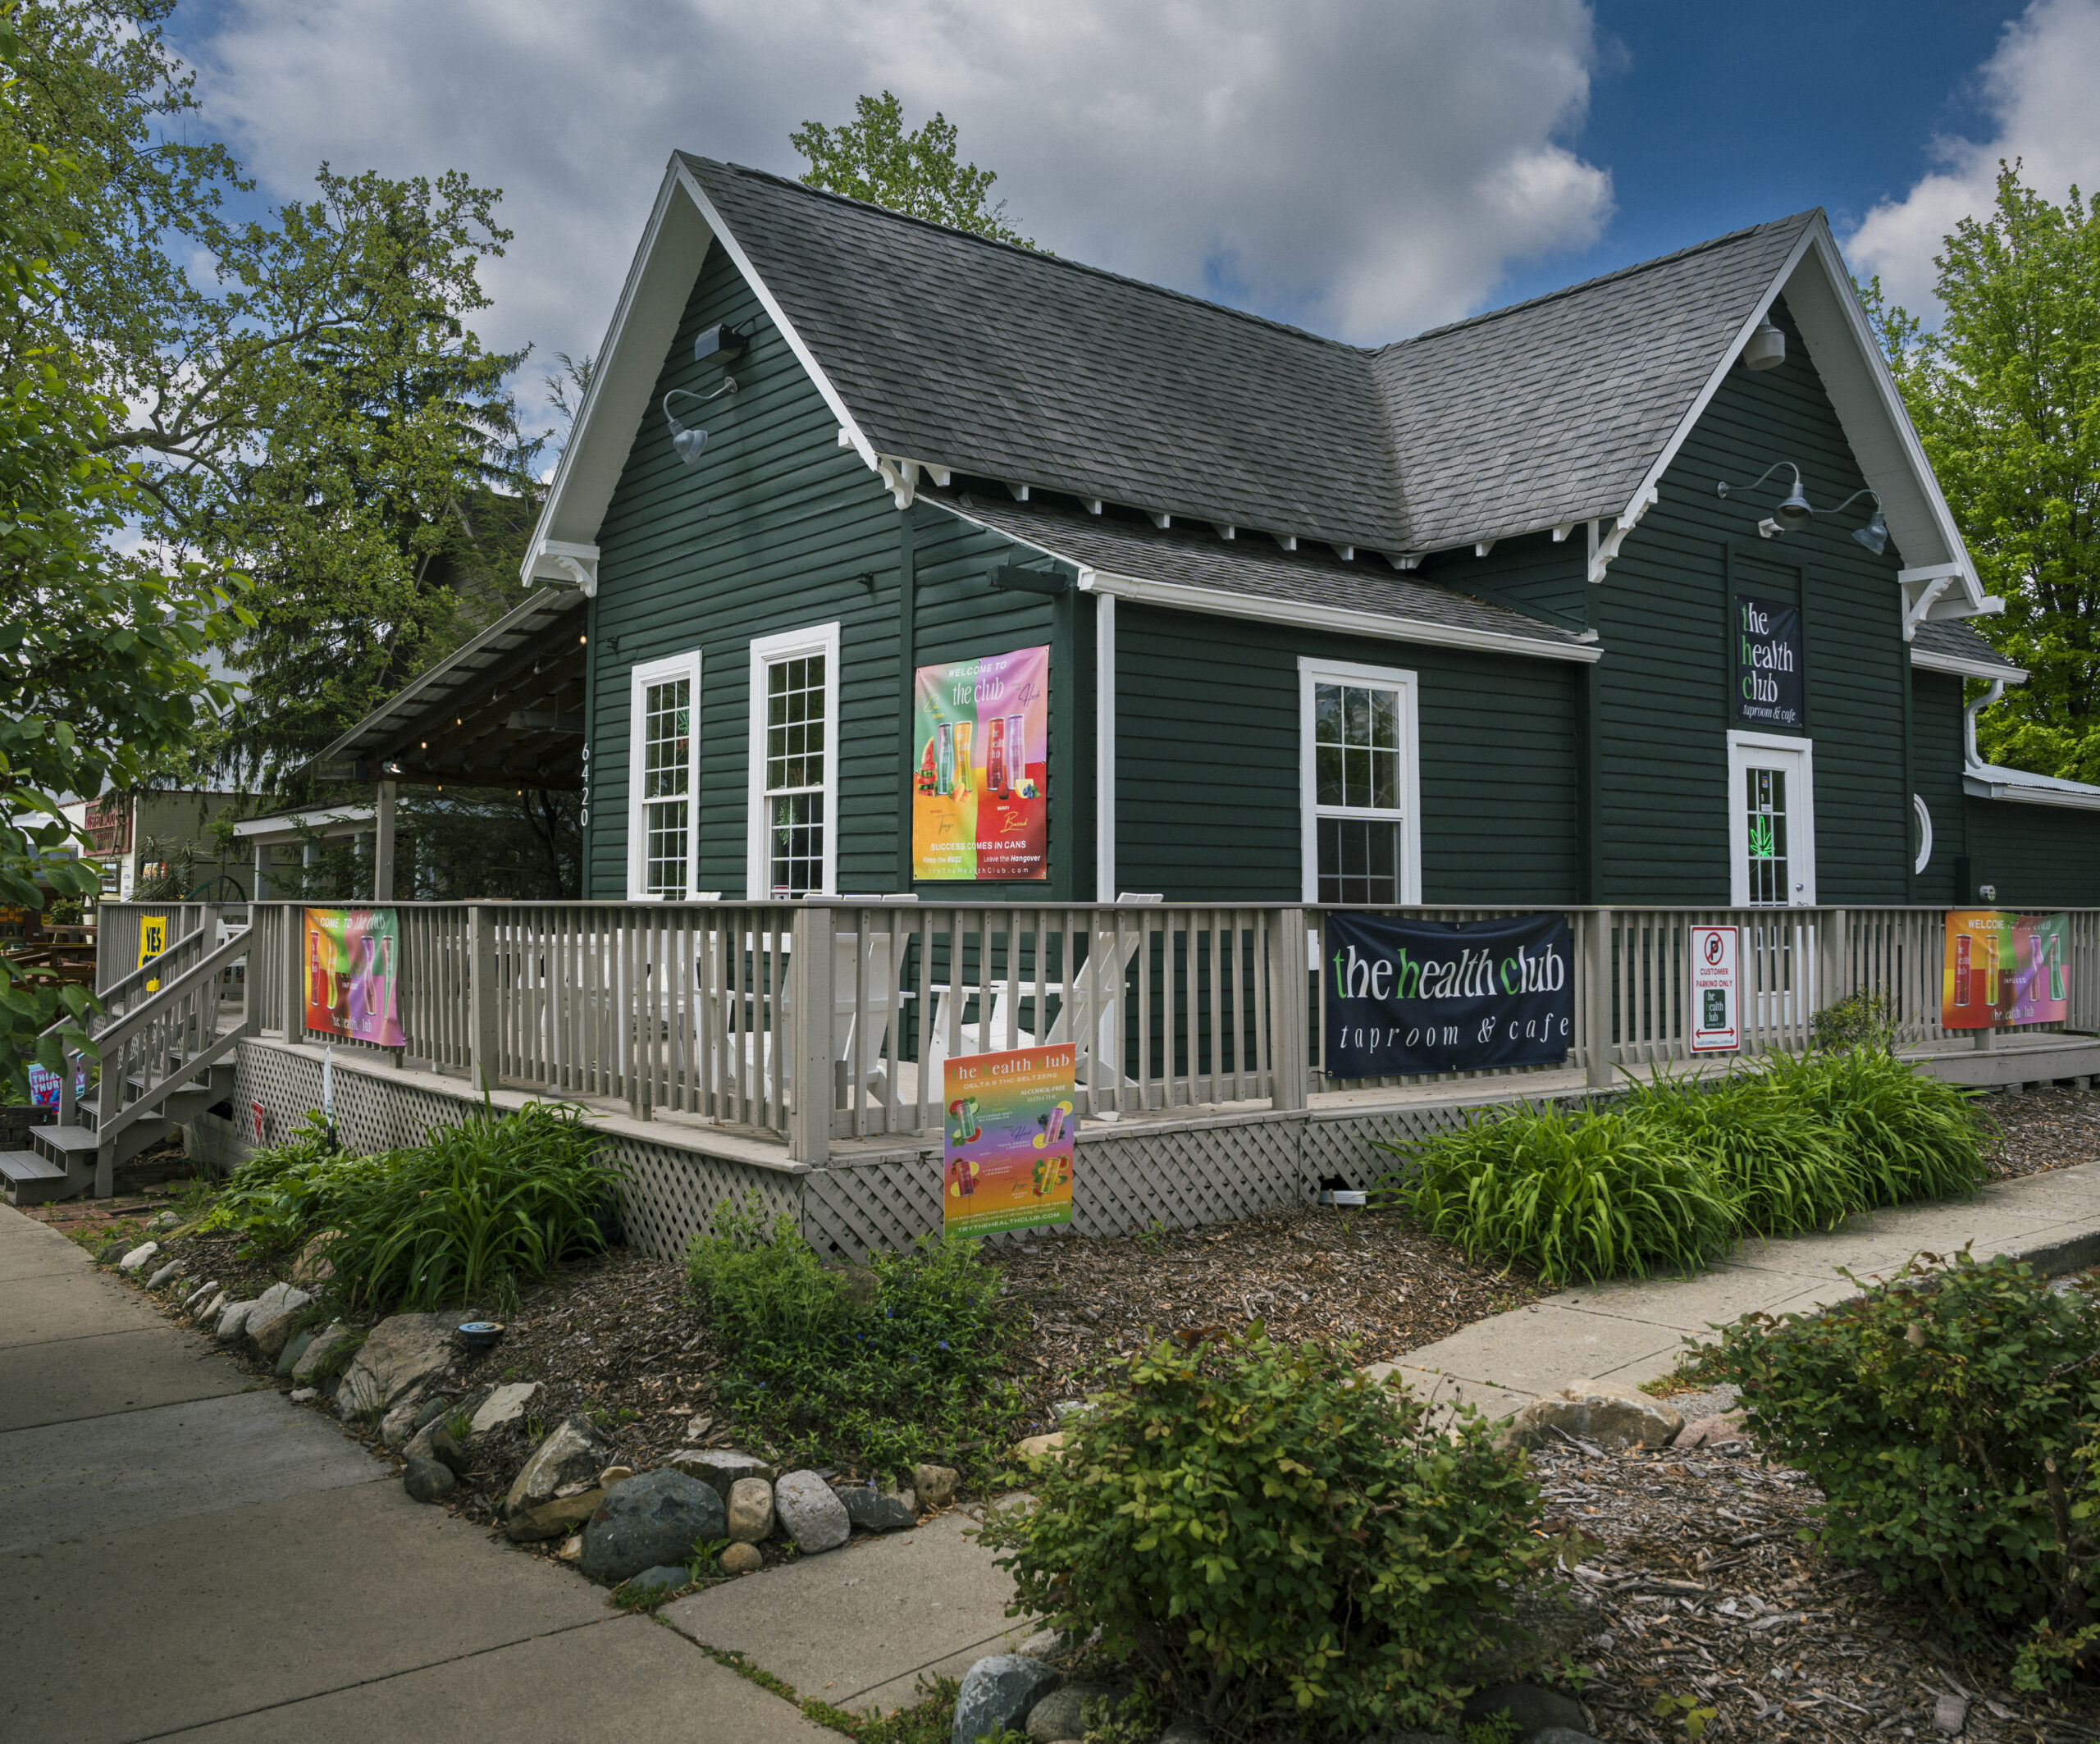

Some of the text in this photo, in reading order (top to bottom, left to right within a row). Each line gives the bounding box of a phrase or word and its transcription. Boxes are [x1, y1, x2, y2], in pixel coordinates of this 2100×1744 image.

[1742, 602, 1769, 635] the
[1742, 635, 1794, 672] health
[948, 661, 1007, 678] WELCOME TO
[952, 683, 972, 706] the
[974, 677, 1004, 703] club
[1742, 670, 1778, 703] club
[1743, 704, 1796, 724] taproom & cafe
[581, 742, 590, 827] 6420
[930, 840, 1026, 851] SUCCESS COMES IN CANS
[923, 856, 937, 865] Keep
[1011, 855, 1041, 864] Hangover
[354, 915, 367, 929] the
[1968, 919, 2005, 929] WELCOME
[146, 926, 162, 952] YES
[1333, 943, 1565, 1001] the health club
[1696, 979, 1718, 988] PARKING
[1340, 1012, 1569, 1054] taproom & cafe
[953, 1053, 1070, 1080] the health club
[964, 1081, 990, 1089] DELTA
[1016, 1072, 1057, 1082] SELTZERS
[1020, 1085, 1066, 1096] ALCOHOL-FREE
[958, 1212, 1060, 1232] TRYTHEHEALTHCLUB.COM
